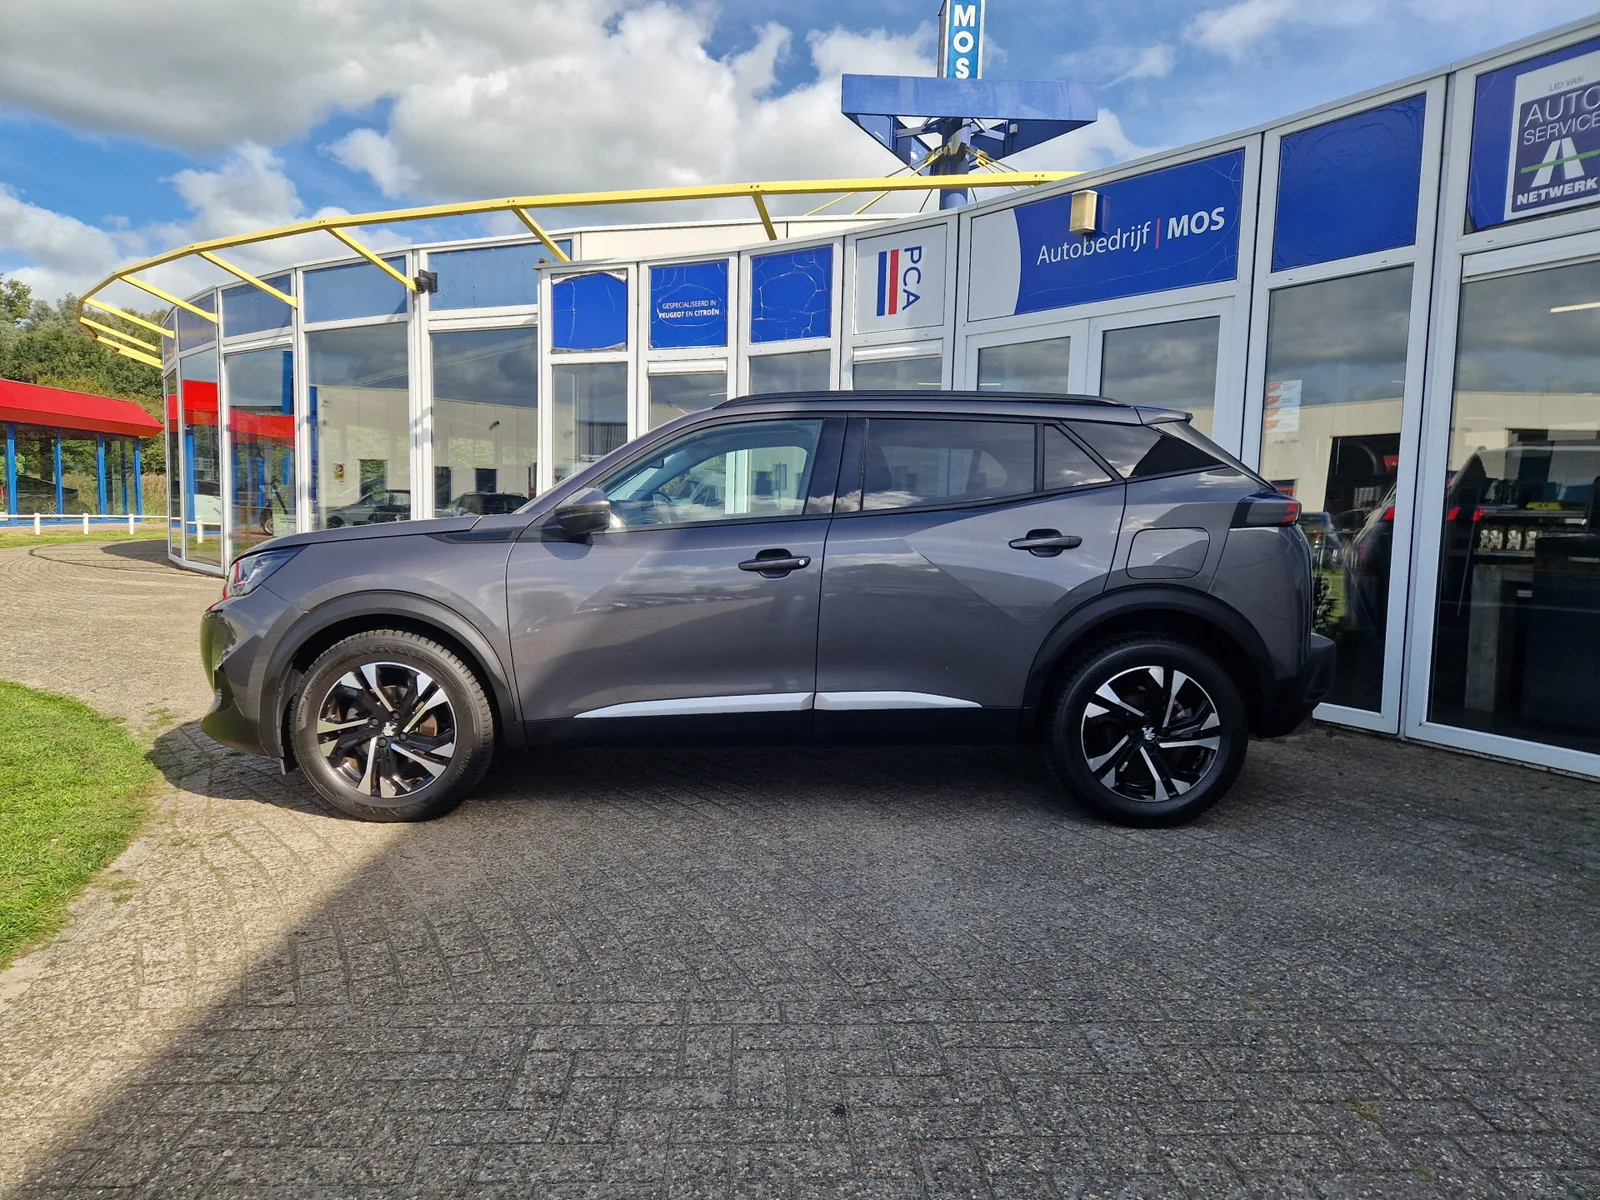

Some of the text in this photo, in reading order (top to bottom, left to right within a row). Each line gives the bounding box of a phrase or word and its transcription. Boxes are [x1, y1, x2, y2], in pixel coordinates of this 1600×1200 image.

[953, 4, 976, 79] MOS
[1549, 75, 1584, 92] LID VAN
[1524, 85, 1600, 127] AUTO
[1517, 176, 1598, 206] NETWERK
[1036, 206, 1225, 265] Autobedrijf MOS
[902, 245, 922, 311] PCA
[659, 308, 720, 319] PEUGEOT EN CITROËN
[661, 300, 709, 309] GESPECIALISEERD
